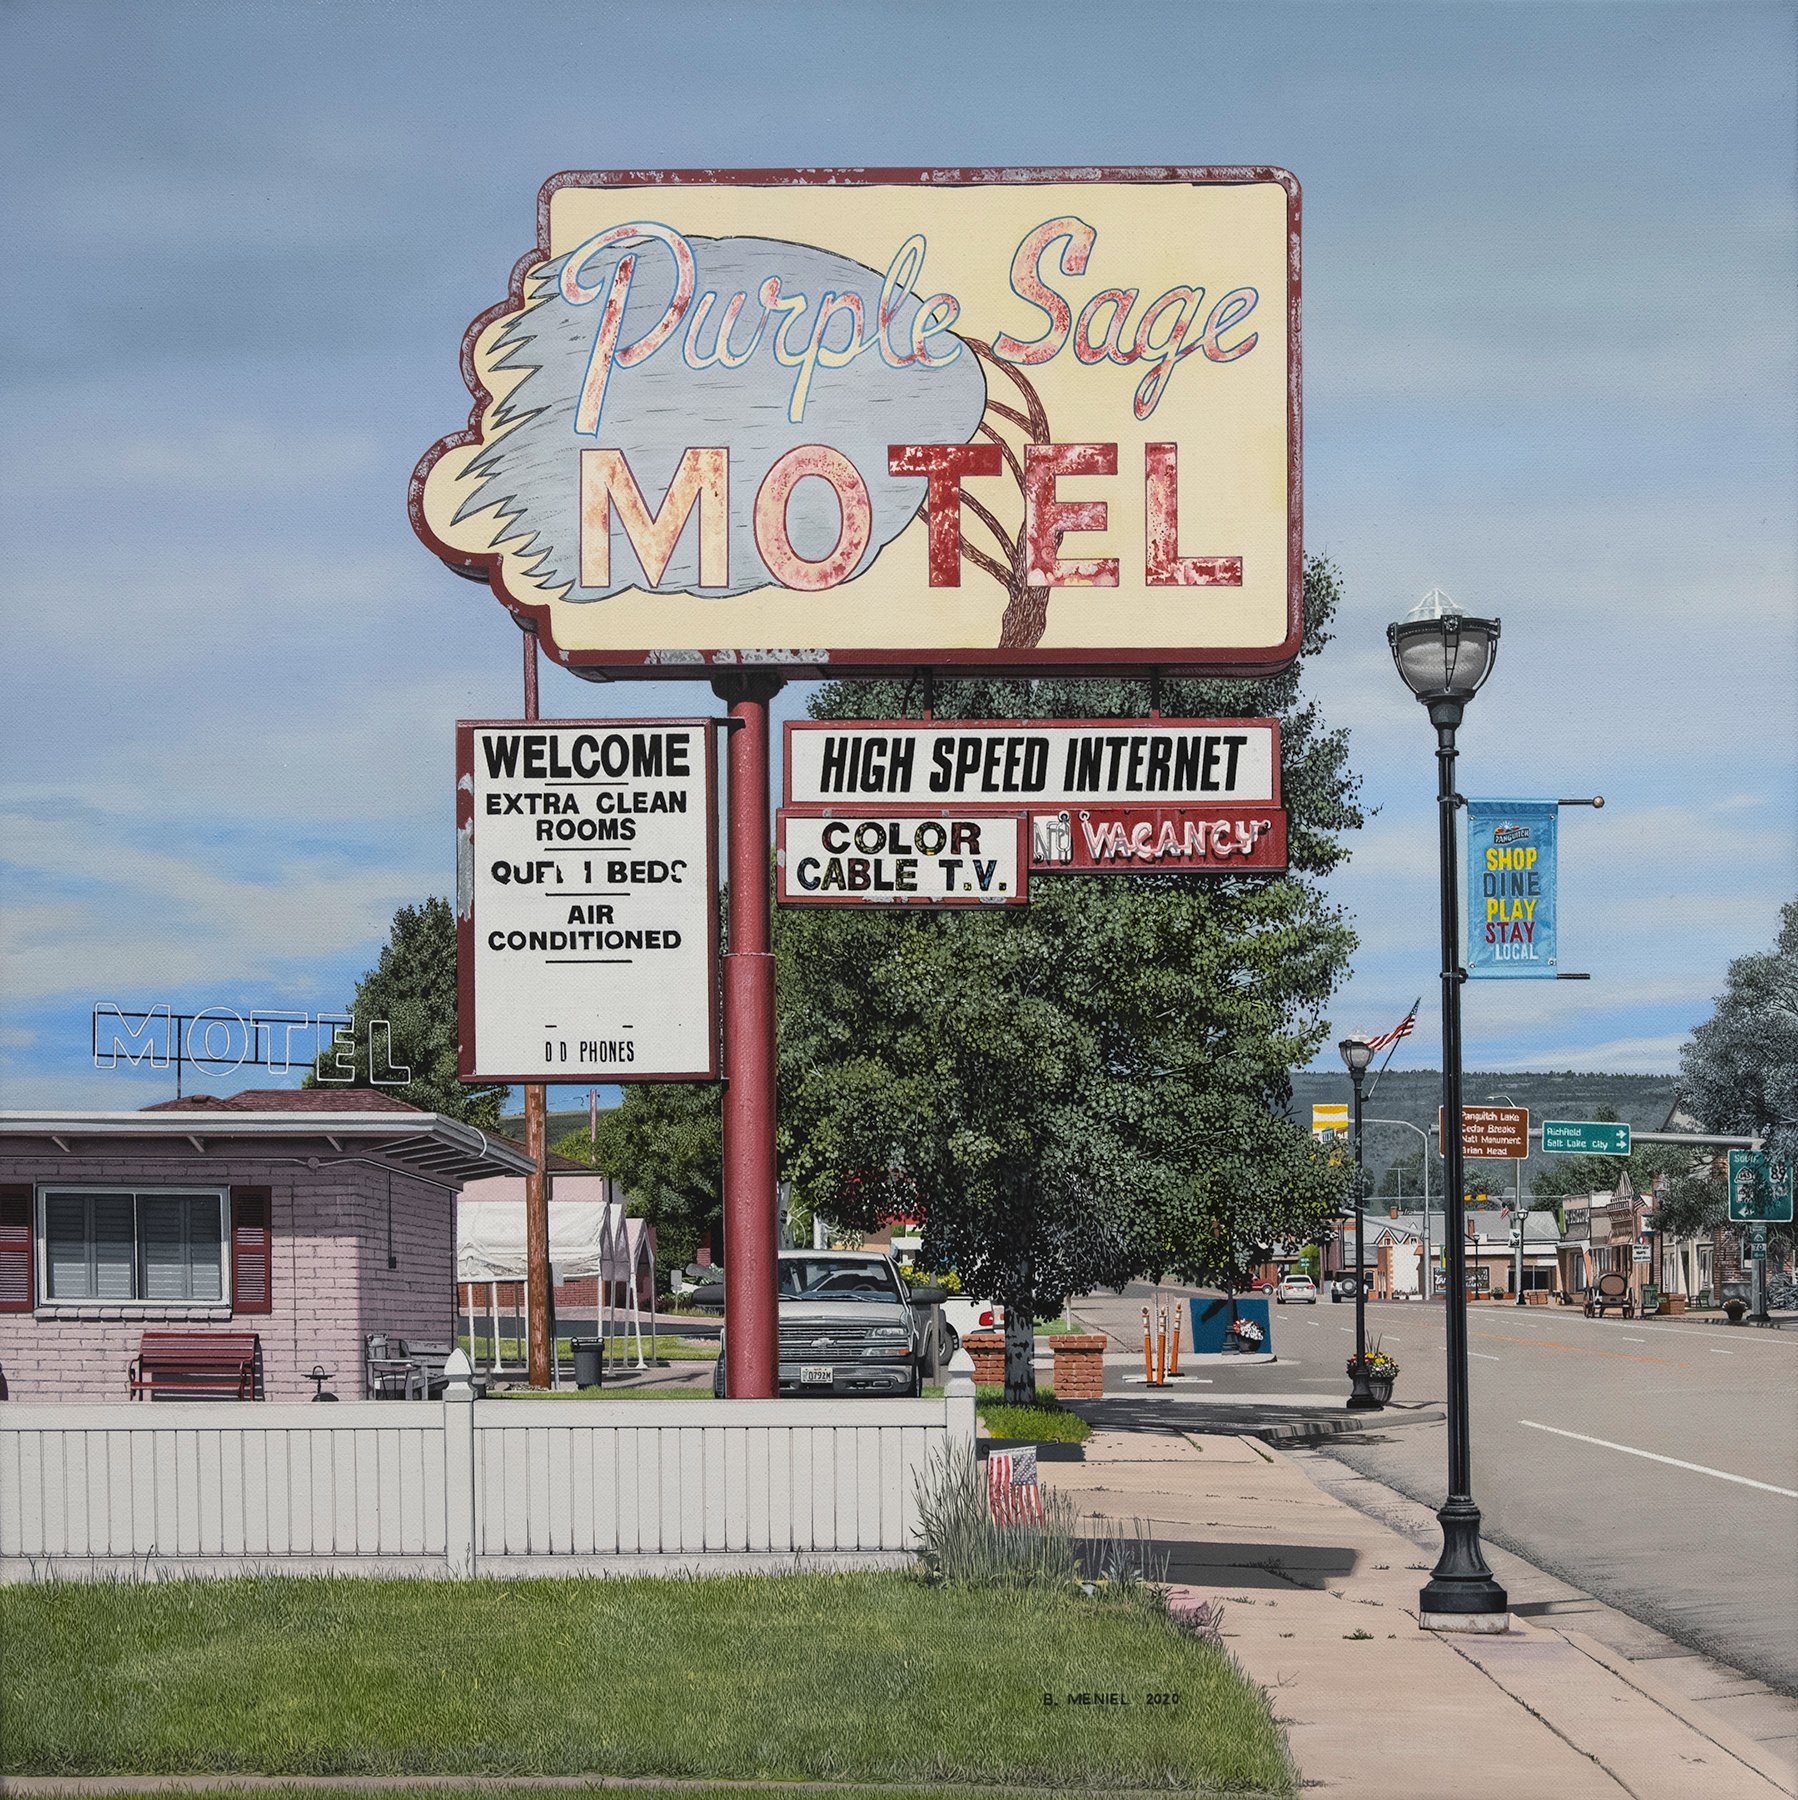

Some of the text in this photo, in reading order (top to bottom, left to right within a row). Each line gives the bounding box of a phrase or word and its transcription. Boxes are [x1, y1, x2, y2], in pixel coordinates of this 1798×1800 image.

[559, 216, 1259, 438] Purple Sage
[578, 441, 1244, 590] MOTEL
[482, 733, 690, 779] WELCOME
[820, 736, 1248, 793] HIGH SPEED INTERNET
[486, 791, 687, 815] EXTRA CLEAN
[536, 818, 637, 841] ROOMS
[822, 821, 982, 856] COLOR
[1080, 815, 1264, 860] VACANCY
[1486, 847, 1537, 870] SHOP
[797, 857, 1007, 891] CABLE T.V.
[1483, 872, 1541, 897] DINE
[568, 905, 614, 925] AIR
[1487, 898, 1537, 921] PLAY
[488, 930, 682, 951] CONDITIONED
[1485, 921, 1535, 944] STAY
[1495, 943, 1539, 960] LOCAL
[95, 1002, 411, 1085] MOTEL
[580, 1041, 635, 1062] PHONES
[1487, 1124, 1516, 1134] Breaks
[1500, 1113, 1520, 1122] Lake
[1481, 1136, 1521, 1145] Monument
[1486, 1147, 1507, 1156] Head
[1547, 1138, 1564, 1147] Salt
[1566, 1139, 1587, 1148] Lake
[1043, 1692, 1179, 1706] B. MENIEL 2020
